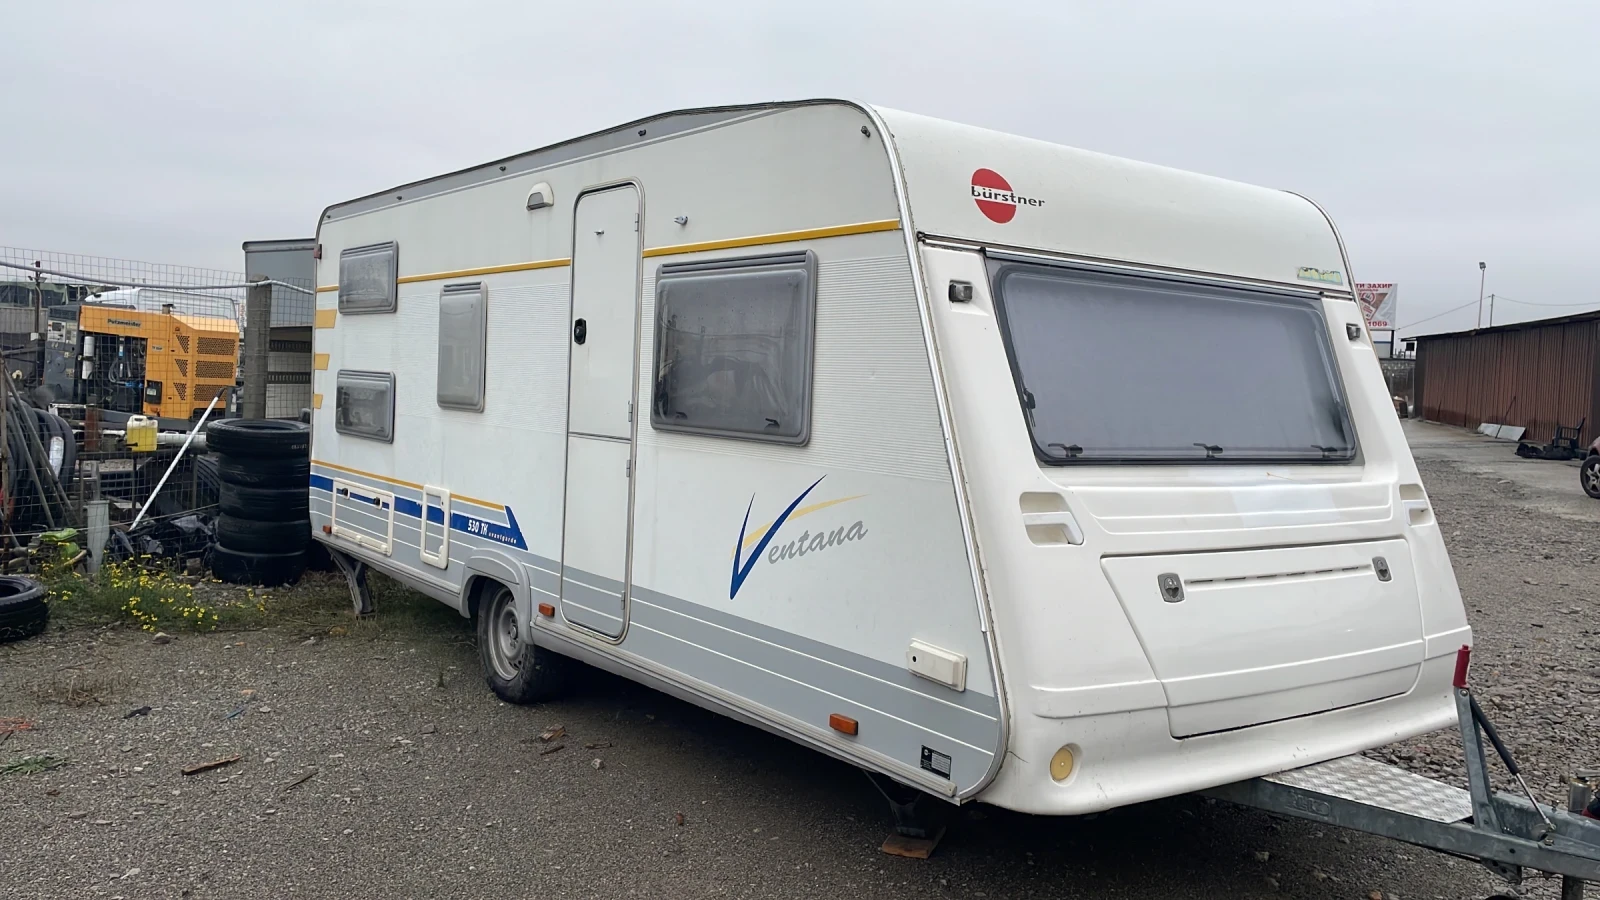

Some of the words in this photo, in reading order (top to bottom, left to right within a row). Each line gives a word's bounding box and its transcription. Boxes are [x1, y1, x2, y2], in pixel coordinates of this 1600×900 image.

[971, 186, 1045, 207] bürstner
[467, 519, 480, 533] 530
[480, 522, 489, 536] TK
[730, 474, 868, 600] Ventana
